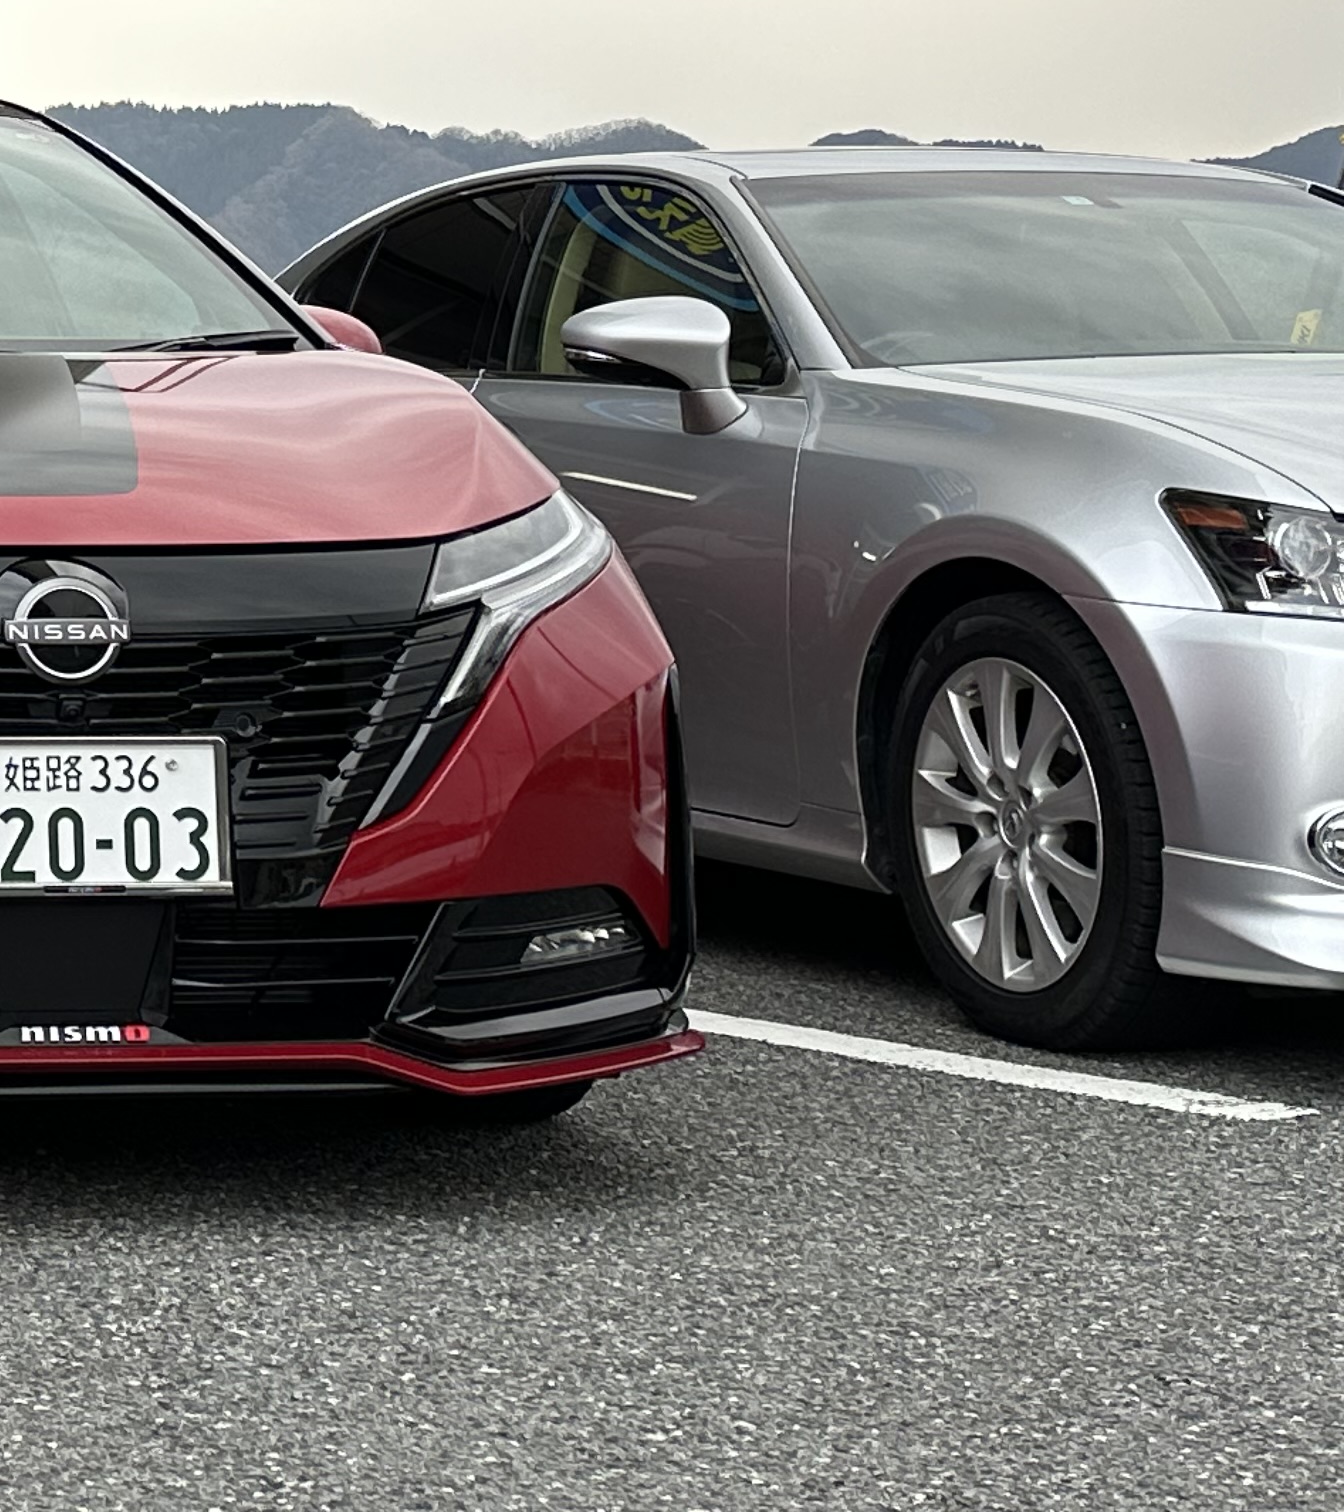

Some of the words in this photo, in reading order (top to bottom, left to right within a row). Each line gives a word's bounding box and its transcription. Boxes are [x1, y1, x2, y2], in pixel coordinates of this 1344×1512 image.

[7, 622, 129, 641] NISSAN
[0, 806, 211, 883] 20-03
[20, 1024, 151, 1044] nismo
